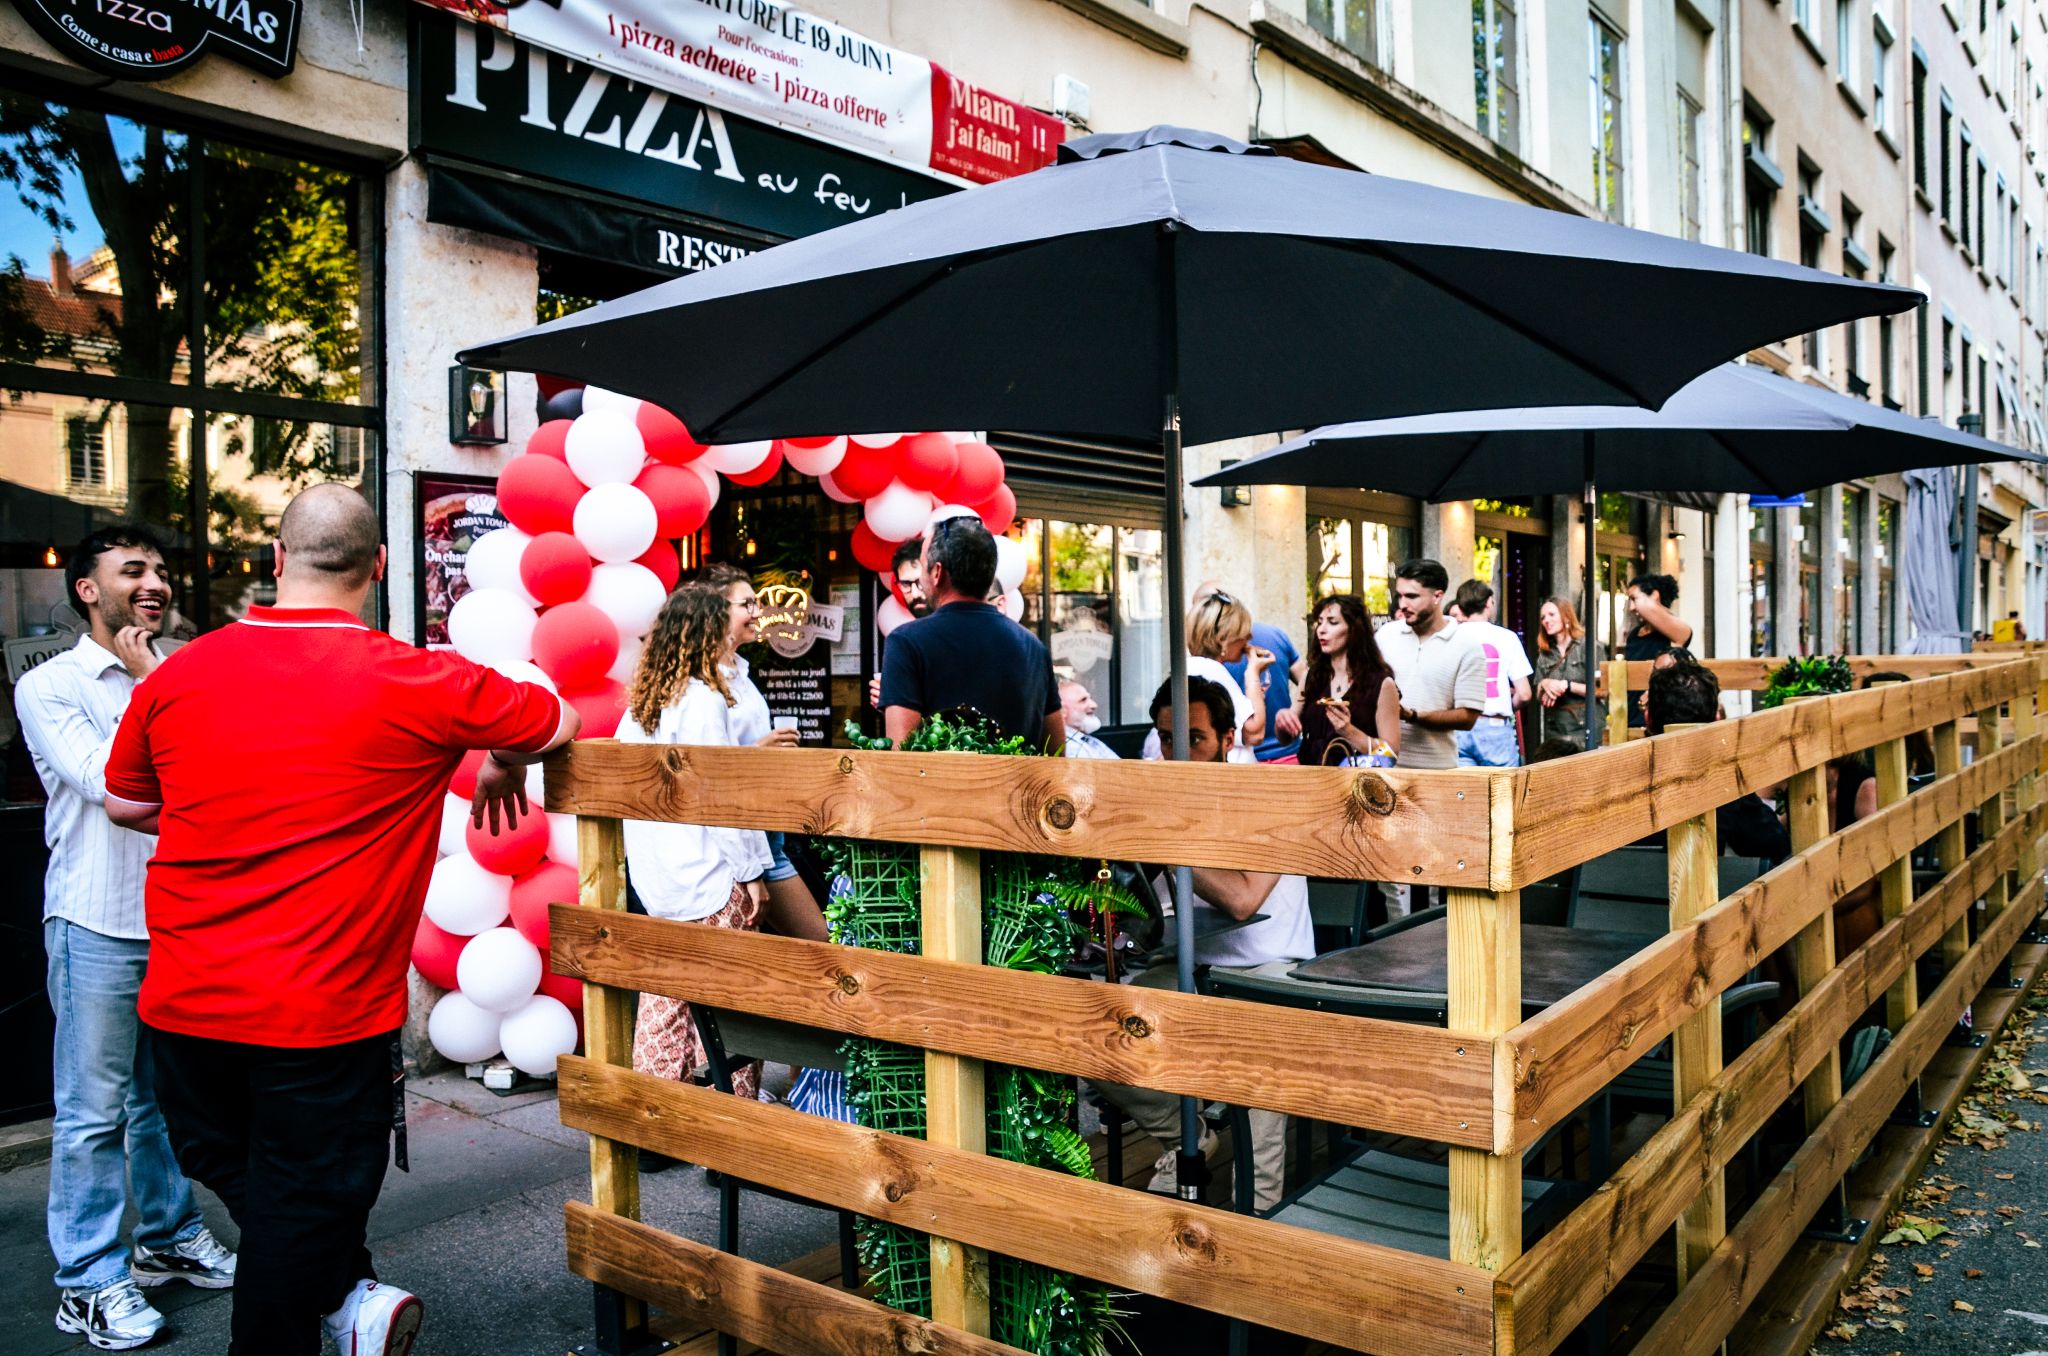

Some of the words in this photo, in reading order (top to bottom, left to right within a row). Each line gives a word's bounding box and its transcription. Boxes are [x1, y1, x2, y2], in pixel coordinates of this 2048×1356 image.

[61, 14, 99, 47] Come
[100, 42, 109, 53] a
[112, 47, 142, 62] casa
[144, 52, 153, 62] e
[152, 44, 184, 60] basta
[718, 24, 744, 46] Pour
[782, 11, 806, 44] LE
[811, 23, 830, 52] 19
[836, 35, 882, 71] JUIN
[608, 13, 615, 36] 1
[620, 20, 675, 58] pizza
[680, 44, 757, 85] achetée
[774, 71, 779, 92] 1
[784, 77, 829, 109] pizza
[834, 94, 887, 128] offerte
[446, 22, 745, 183] PIZZA
[814, 172, 870, 214] feu
[950, 75, 1020, 135] Miam,
[976, 126, 1012, 161] faim
[657, 230, 758, 271] REST
[425, 549, 441, 562] On
